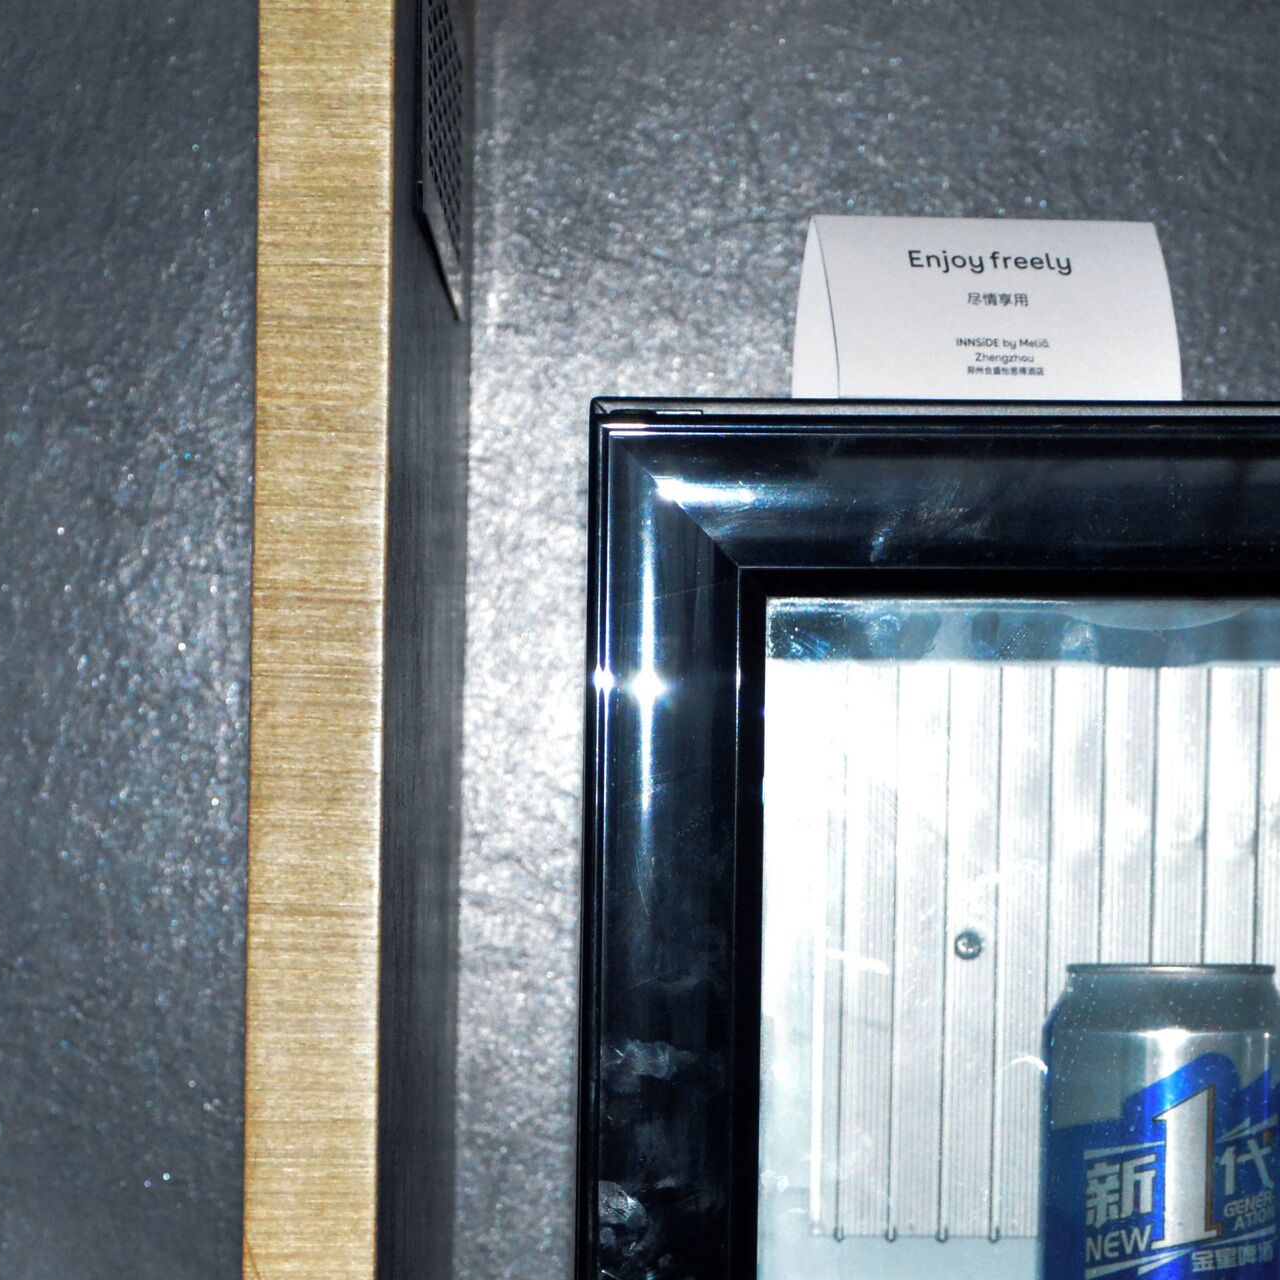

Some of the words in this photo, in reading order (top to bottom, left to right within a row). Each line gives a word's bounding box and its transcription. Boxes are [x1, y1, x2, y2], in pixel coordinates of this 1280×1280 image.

[908, 249, 985, 274] Enjoy
[990, 251, 1073, 275] freely
[967, 292, 1030, 308] 尽情享用
[1002, 338, 1017, 350] by
[975, 352, 1035, 365] Zhengzhou
[1233, 1205, 1276, 1232] ATION
[1085, 1224, 1152, 1263] NEW
